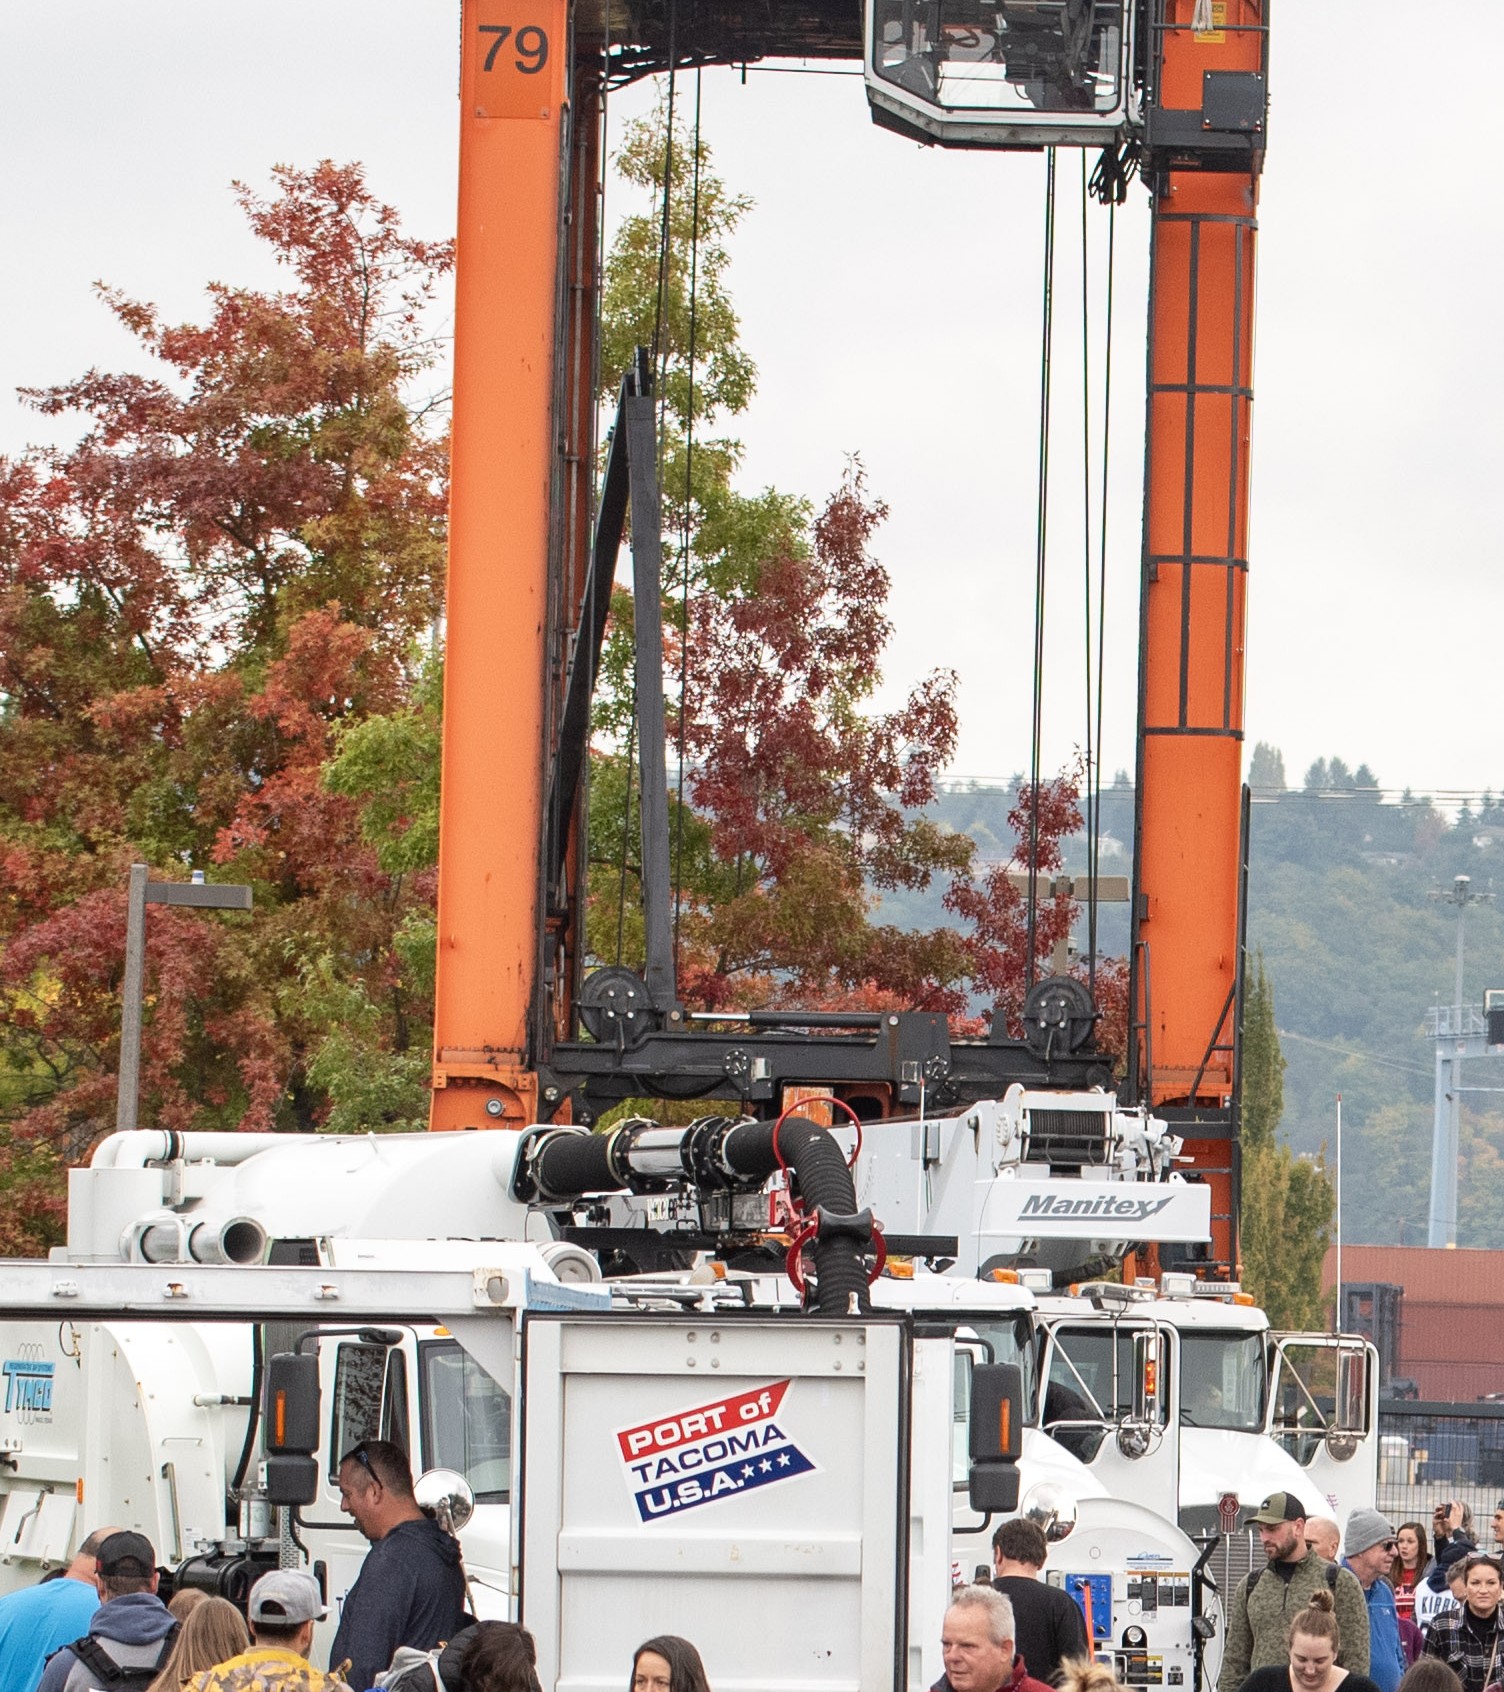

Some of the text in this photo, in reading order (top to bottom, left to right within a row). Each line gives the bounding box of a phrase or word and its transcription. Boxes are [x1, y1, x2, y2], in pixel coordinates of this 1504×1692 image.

[478, 24, 549, 75] 79
[1021, 1194, 1158, 1217] Manitex
[627, 1390, 772, 1456] PORT of
[631, 1423, 788, 1484] TACOMA
[644, 1470, 745, 1514] U.S.A.
